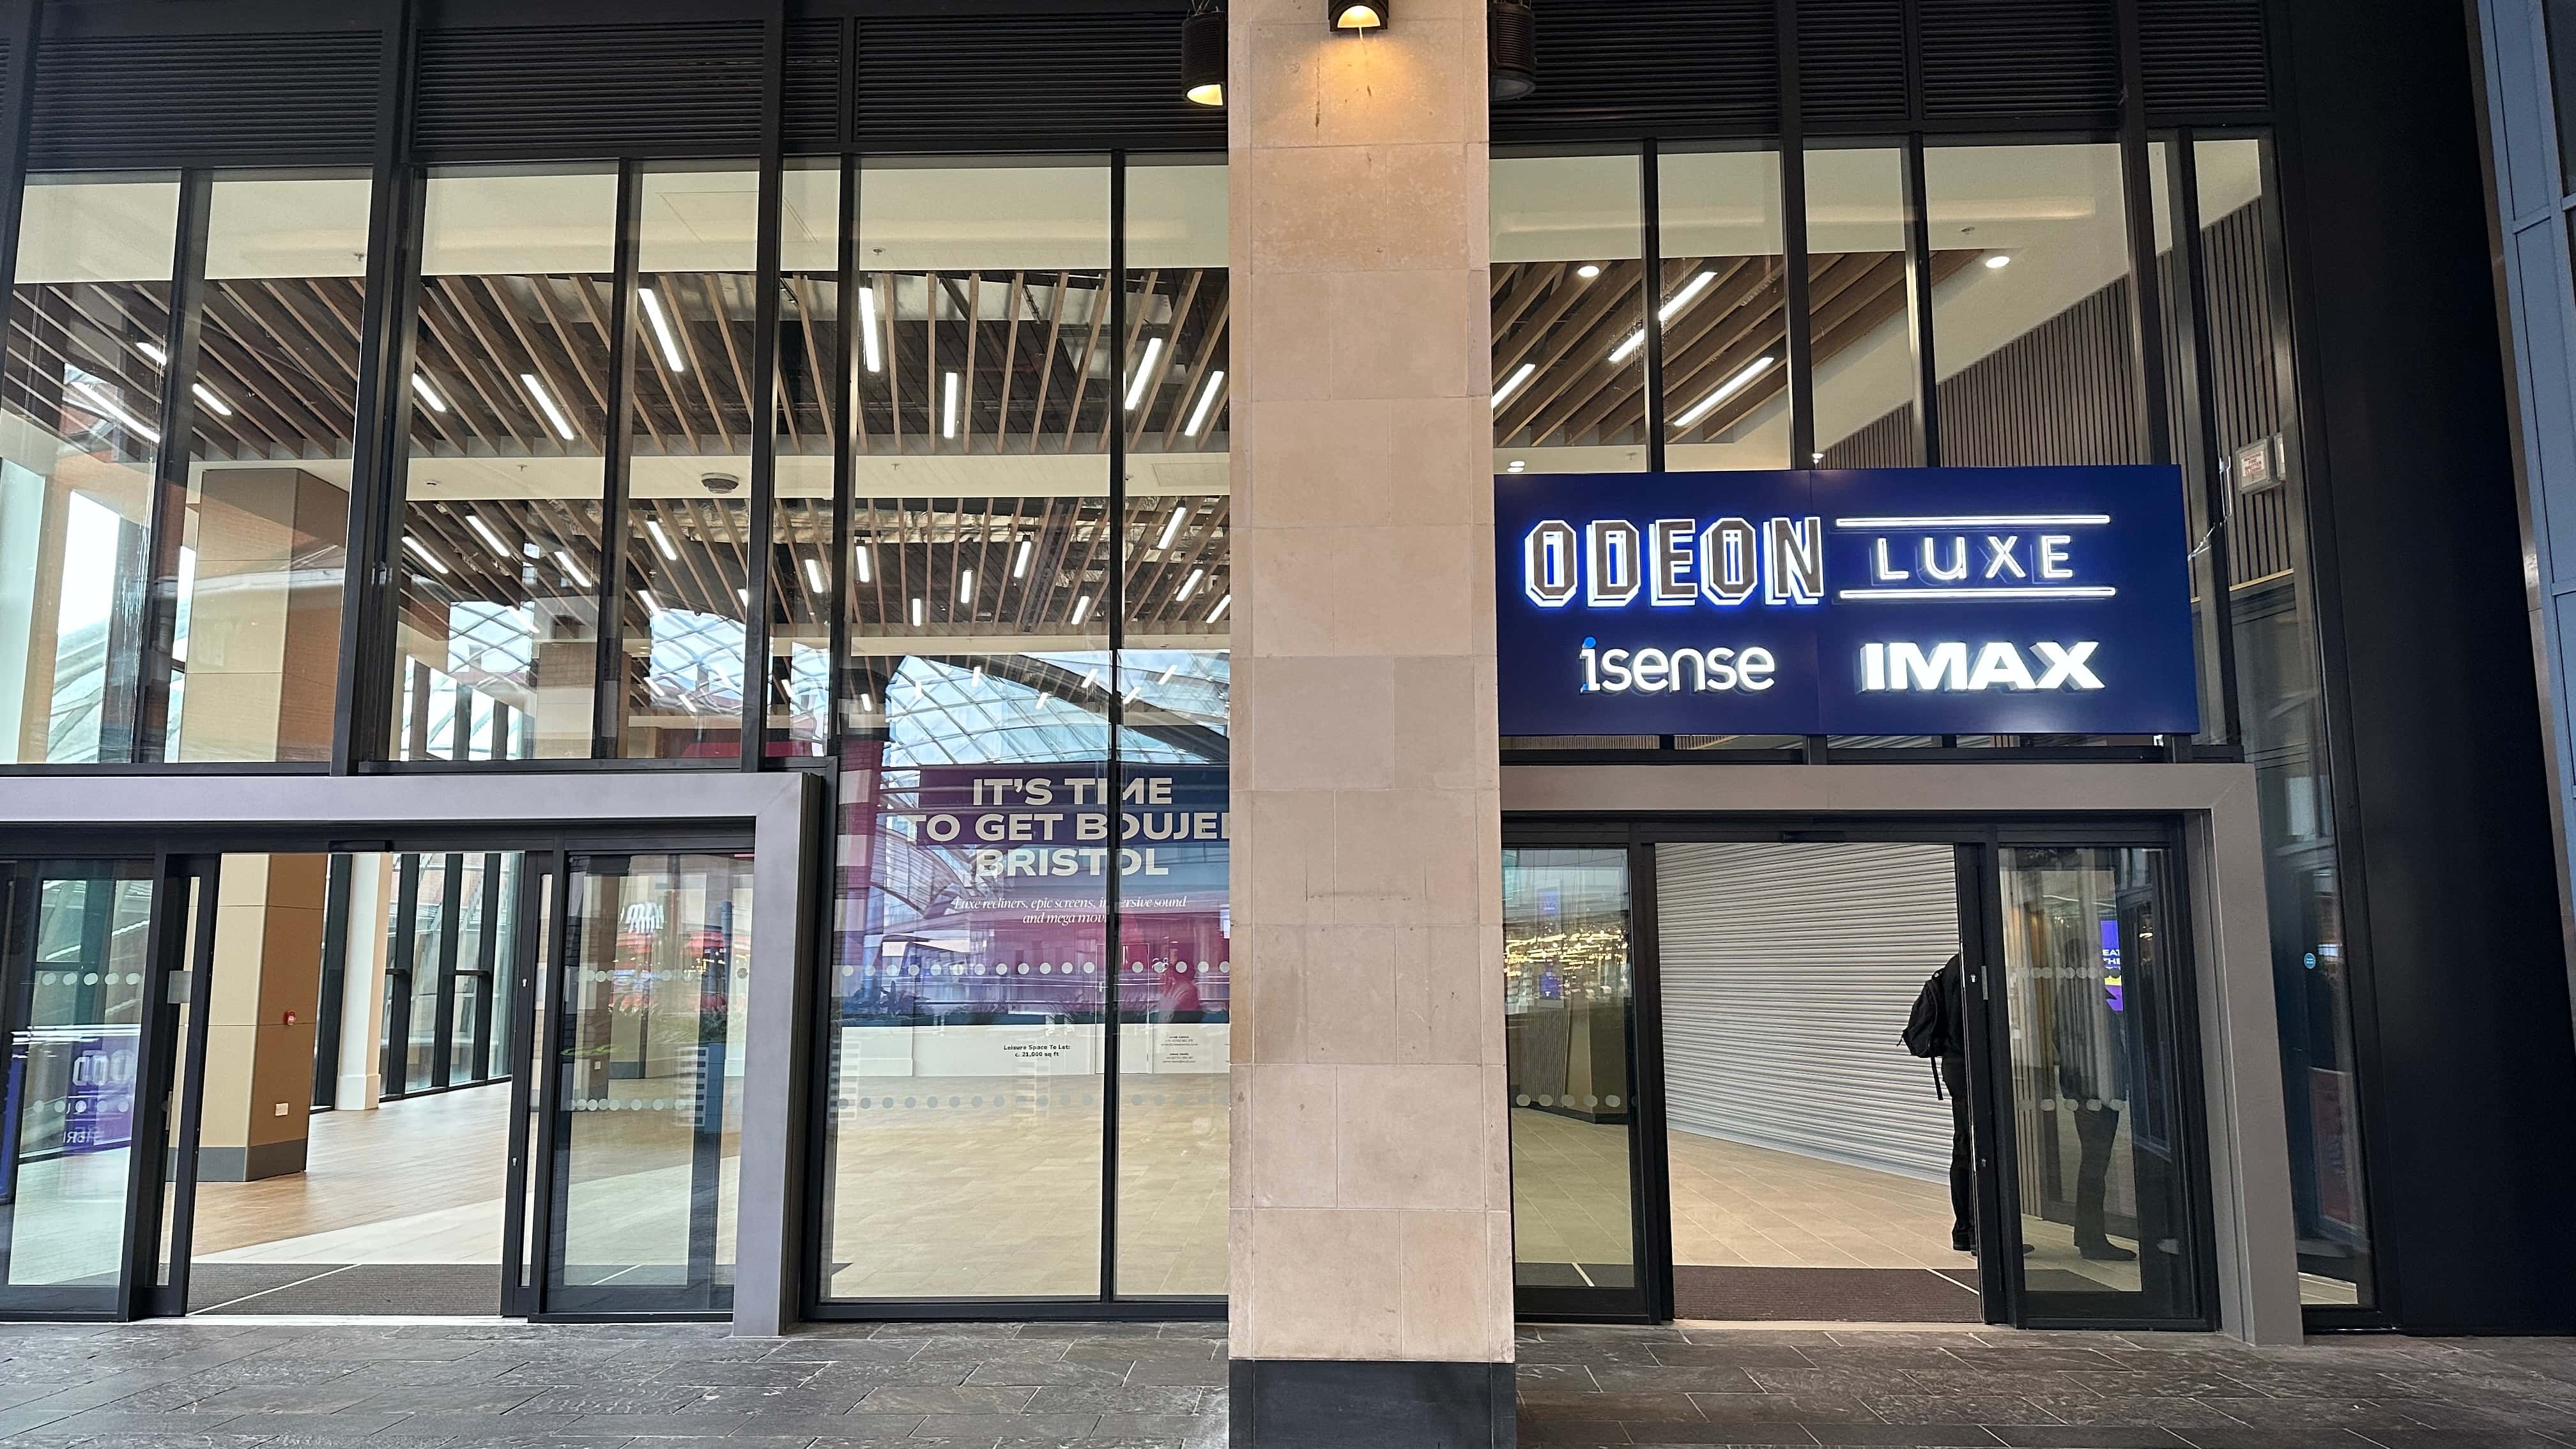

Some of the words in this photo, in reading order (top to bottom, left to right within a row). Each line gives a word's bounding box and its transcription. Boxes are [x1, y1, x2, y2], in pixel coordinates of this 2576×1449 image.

[1524, 517, 1825, 607] ODEON
[1877, 535, 2073, 580] LUXE
[1580, 636, 1775, 694] isense
[1860, 641, 2106, 691] IMAX
[973, 778, 1053, 806] IT'S
[897, 814, 960, 841] TO
[975, 813, 1064, 841] GET
[976, 848, 1169, 877] BRISTOL
[983, 897, 1028, 910] recliners,
[1031, 898, 1053, 911] epic
[1055, 899, 1096, 910] screens,
[1154, 895, 1187, 908] sound
[1022, 913, 1045, 924] and
[1046, 916, 1076, 926] mega
